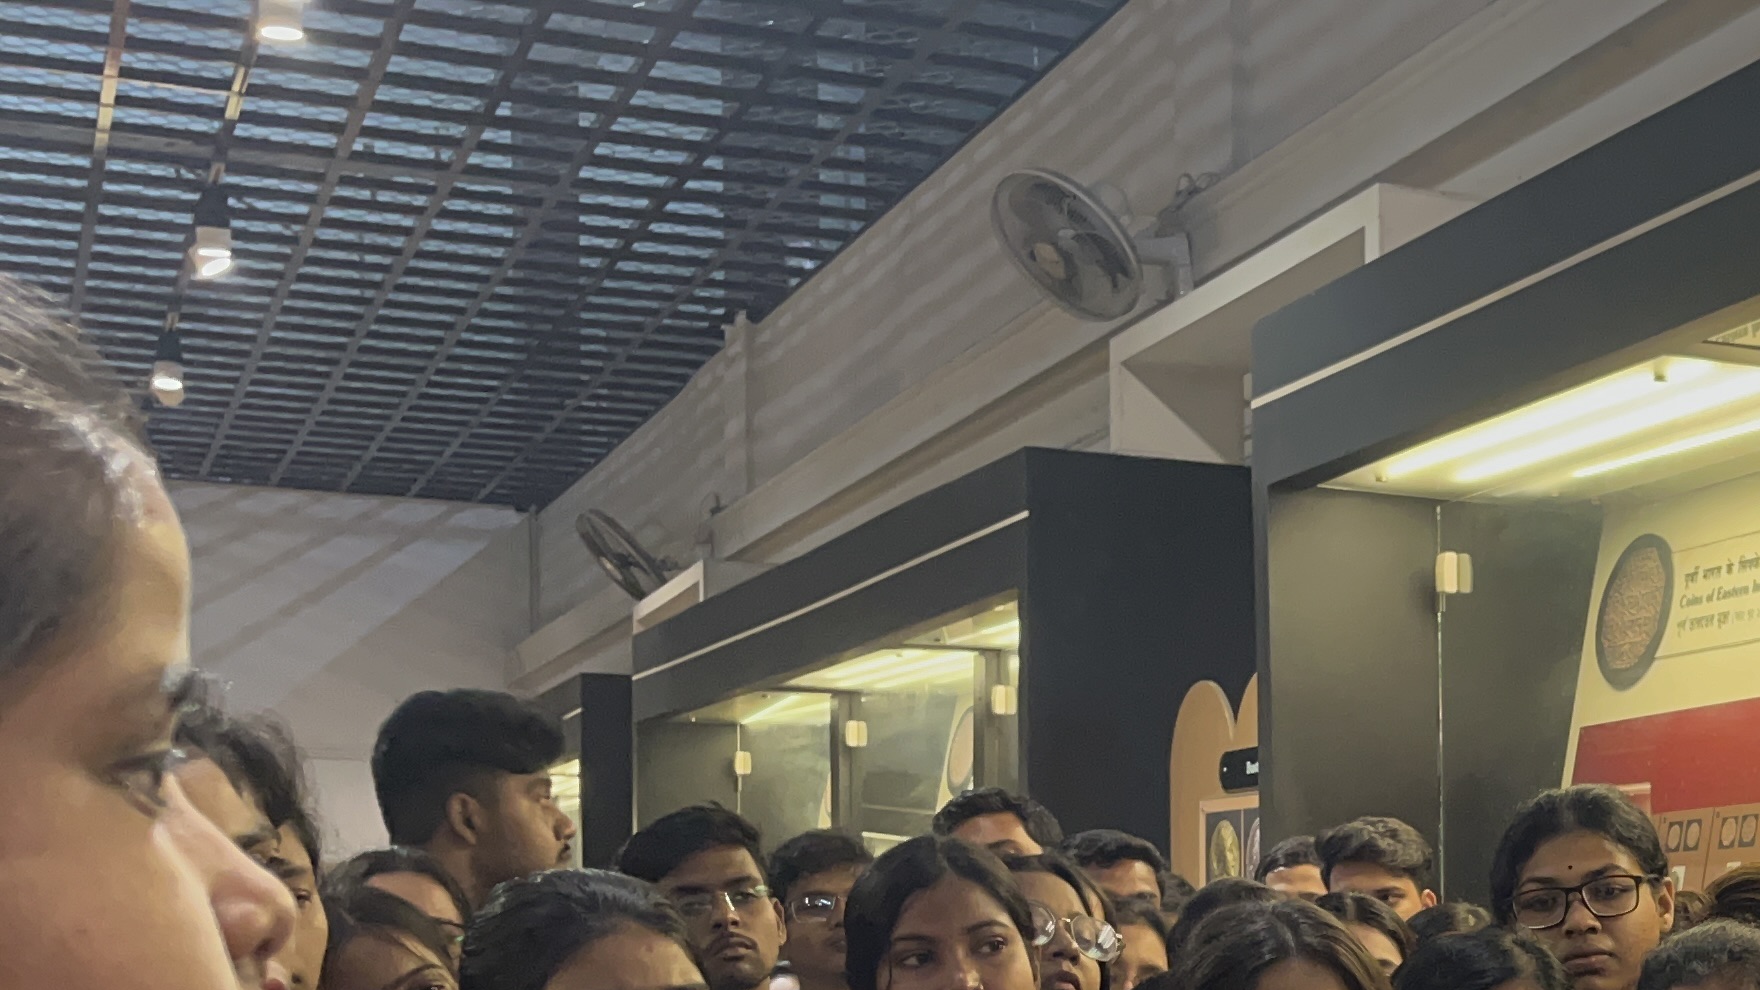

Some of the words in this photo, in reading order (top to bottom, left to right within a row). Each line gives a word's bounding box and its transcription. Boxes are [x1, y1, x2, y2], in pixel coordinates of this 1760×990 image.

[1680, 594, 1703, 609] Coins
[1706, 588, 1715, 603] of
[1717, 586, 1749, 601] Eastern
